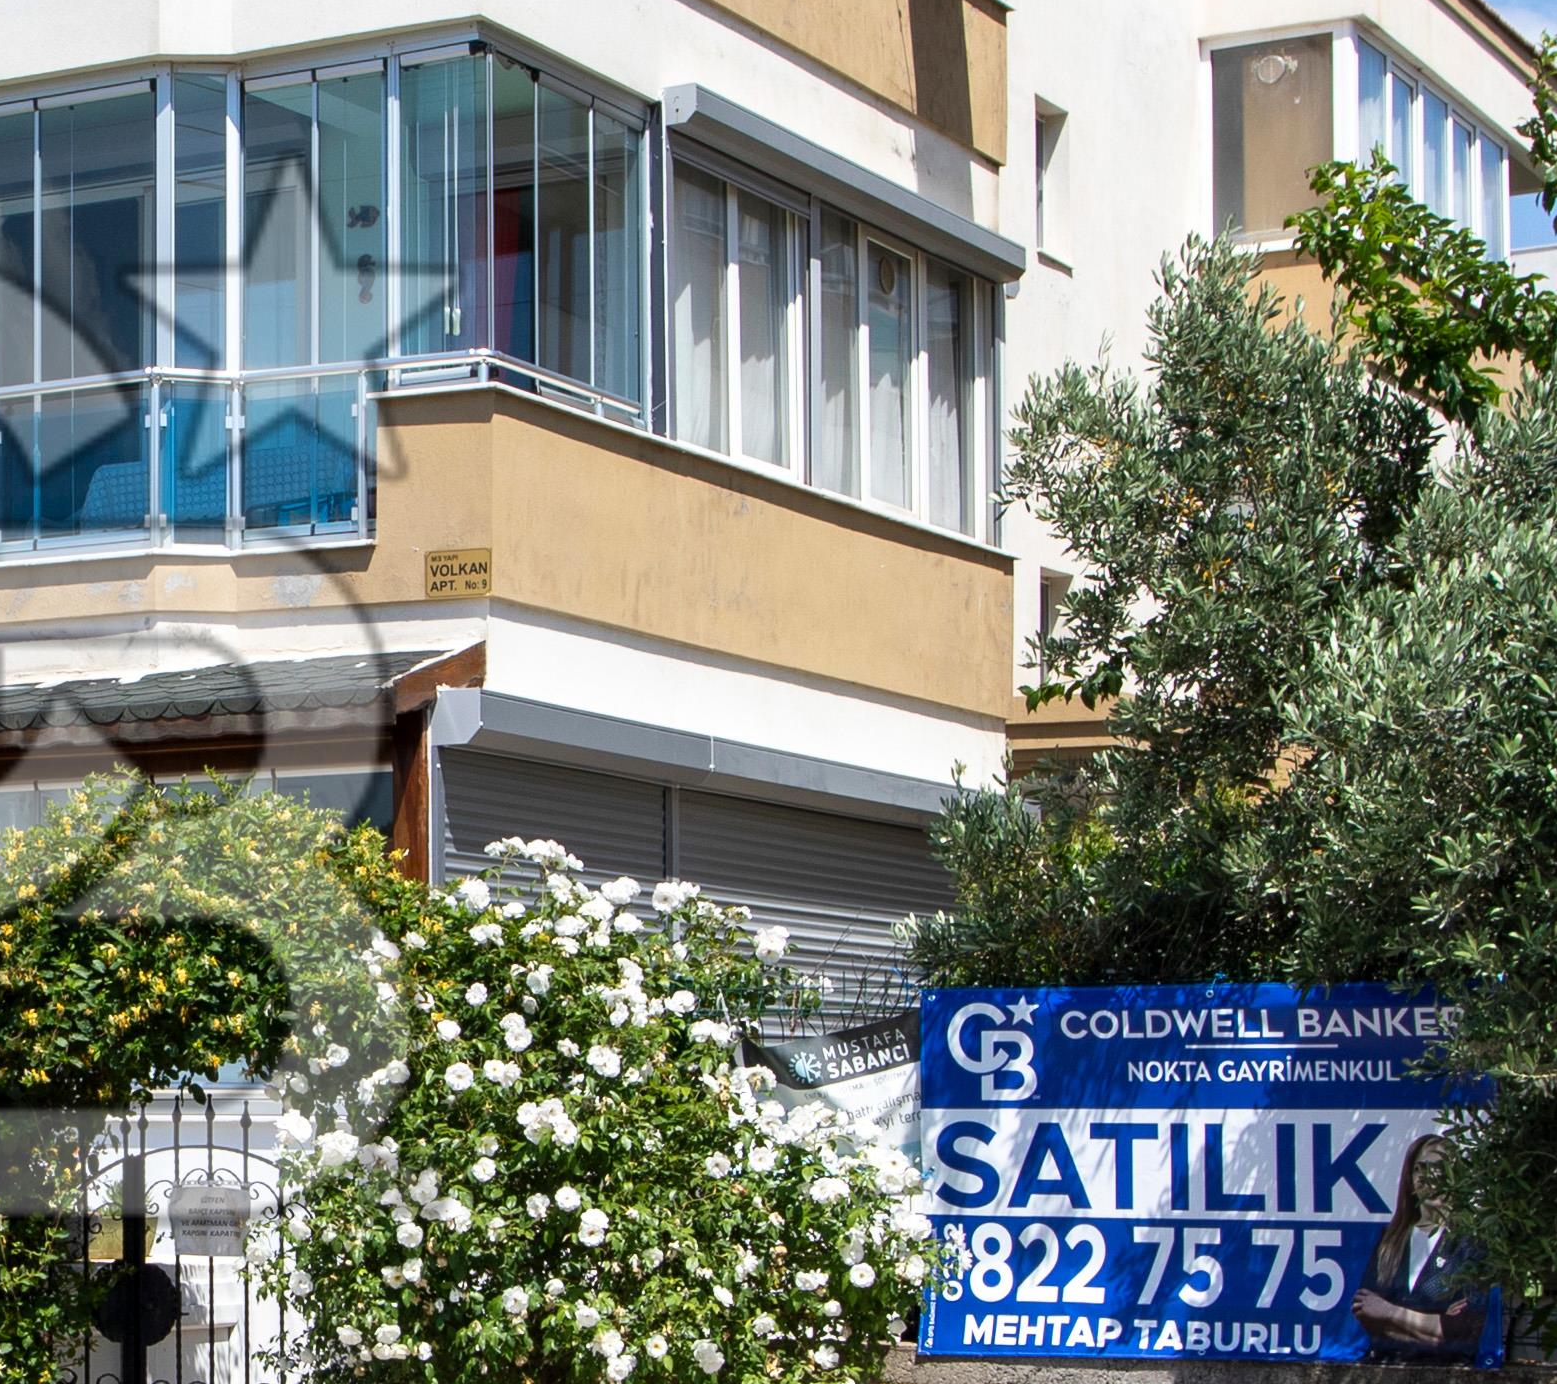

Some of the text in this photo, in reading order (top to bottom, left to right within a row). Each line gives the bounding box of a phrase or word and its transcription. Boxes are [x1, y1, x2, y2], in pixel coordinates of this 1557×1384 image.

[430, 562, 487, 577] VOLKAN
[430, 580, 457, 592] APT.
[1060, 1008, 1284, 1040] COLDWELL
[822, 1027, 906, 1061] MUSTAFA
[827, 1043, 910, 1079] SABANCI
[947, 1002, 1038, 1101] CB
[1127, 1055, 1401, 1083] NOKTA GAYRİMENKUL
[935, 1120, 1393, 1214] SATILIK
[969, 1222, 1345, 1313] 822 75 75
[963, 1313, 1322, 1355] MEHTAP TABURLU
